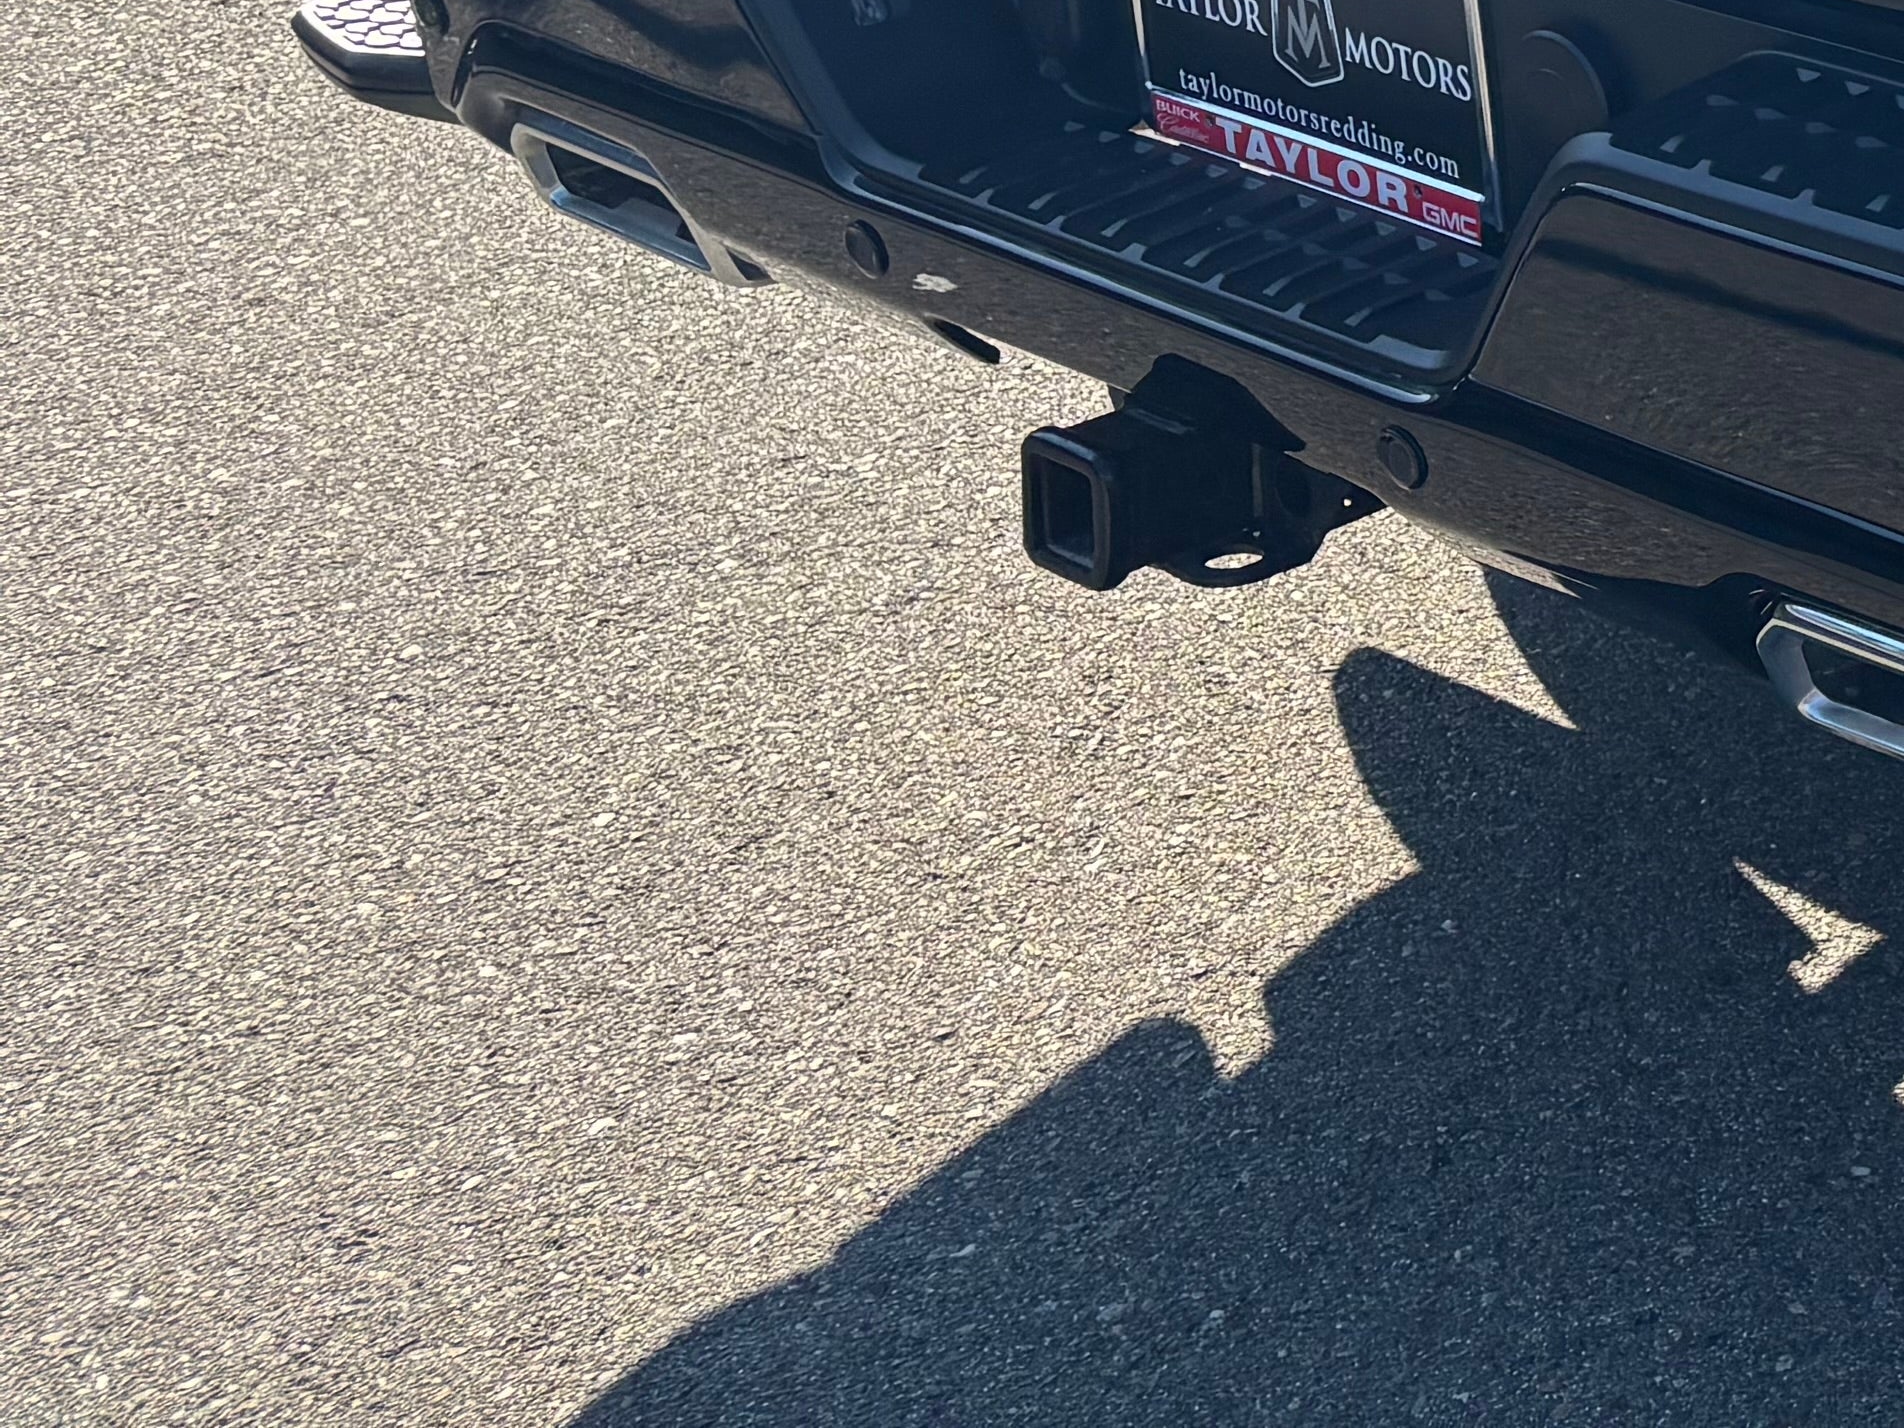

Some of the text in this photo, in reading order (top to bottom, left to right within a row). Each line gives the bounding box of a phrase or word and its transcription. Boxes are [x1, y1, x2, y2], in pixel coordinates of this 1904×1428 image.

[1345, 27, 1473, 102] MOTORS
[1156, 99, 1201, 123] BUICK
[1179, 67, 1460, 180] taylormotorsredding.com
[1215, 117, 1410, 214] TAYLOR
[1421, 201, 1479, 238] GMC
